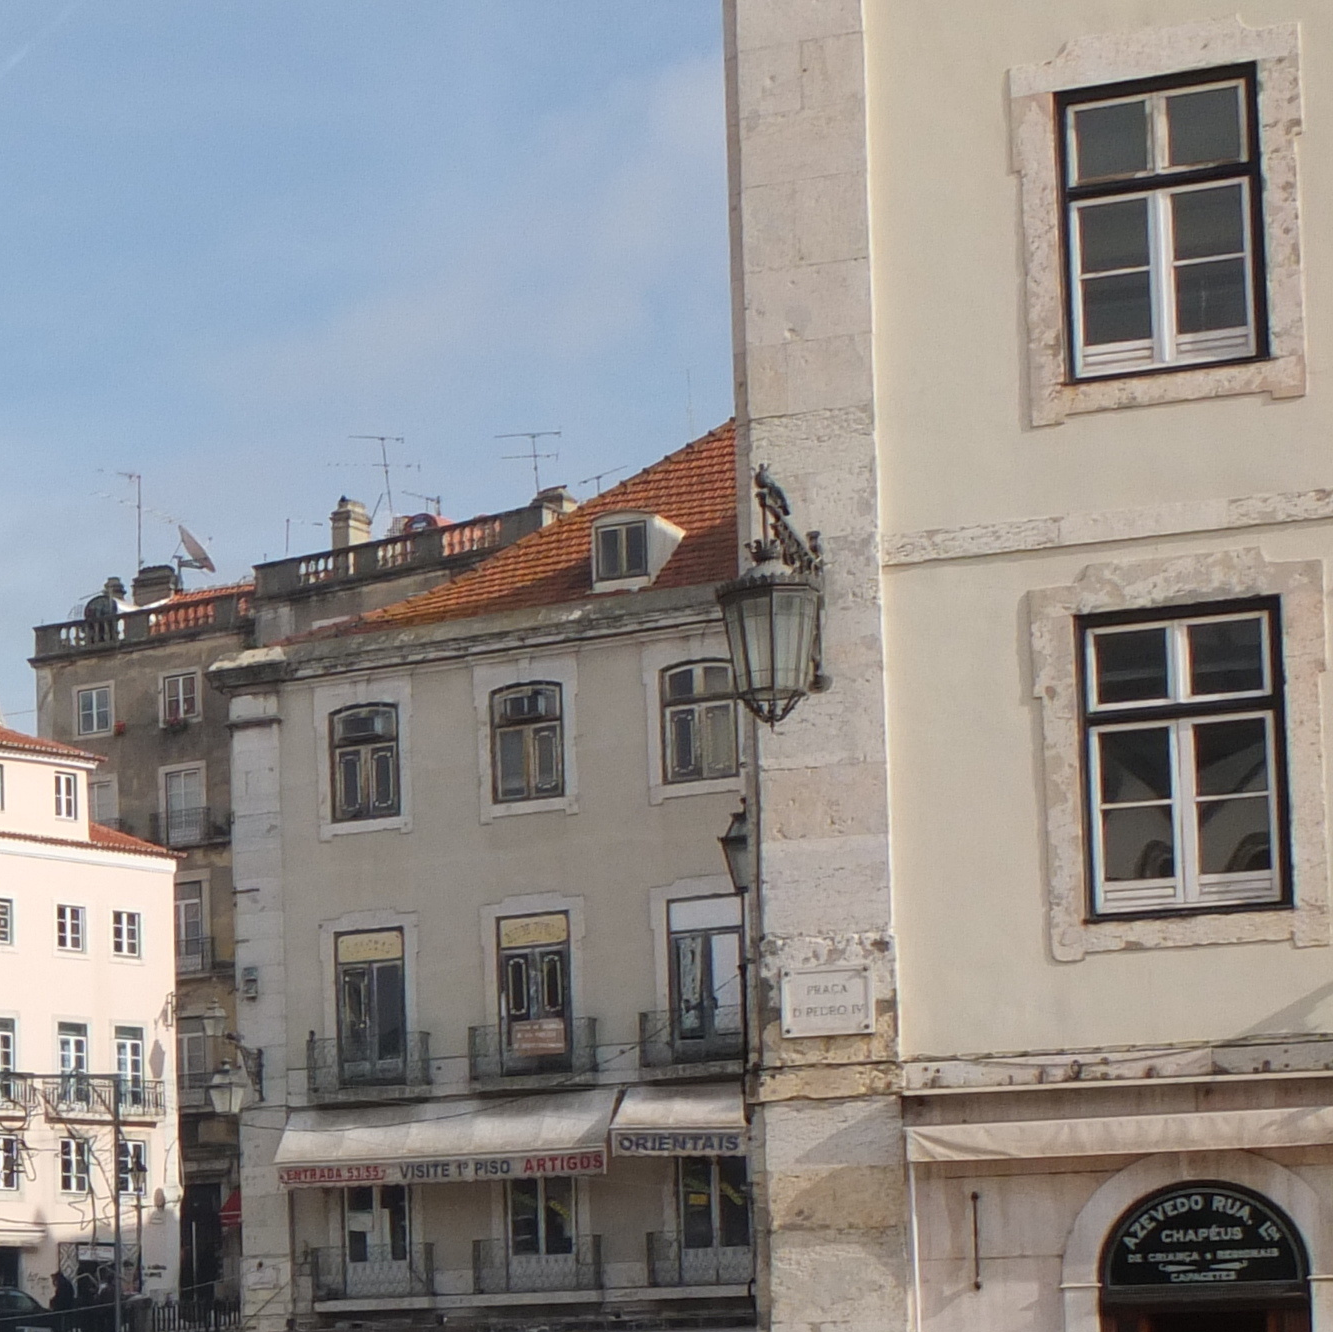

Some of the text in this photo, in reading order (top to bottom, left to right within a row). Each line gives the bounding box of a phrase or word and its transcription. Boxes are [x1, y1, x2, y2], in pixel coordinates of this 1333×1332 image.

[806, 1004, 847, 1016] PEDRO
[286, 1167, 343, 1181] ENTRADA
[399, 1163, 450, 1179] VISITE
[475, 1160, 511, 1175] PISO
[523, 1154, 604, 1173] ARTIGOS
[618, 1136, 739, 1151] ORIENTAIS
[1122, 1195, 1204, 1250] AZEVEDO
[1161, 1225, 1243, 1243] CHAPÉUS
[1127, 1253, 1143, 1262] DE
[1147, 1251, 1201, 1263] CRIANÇA
